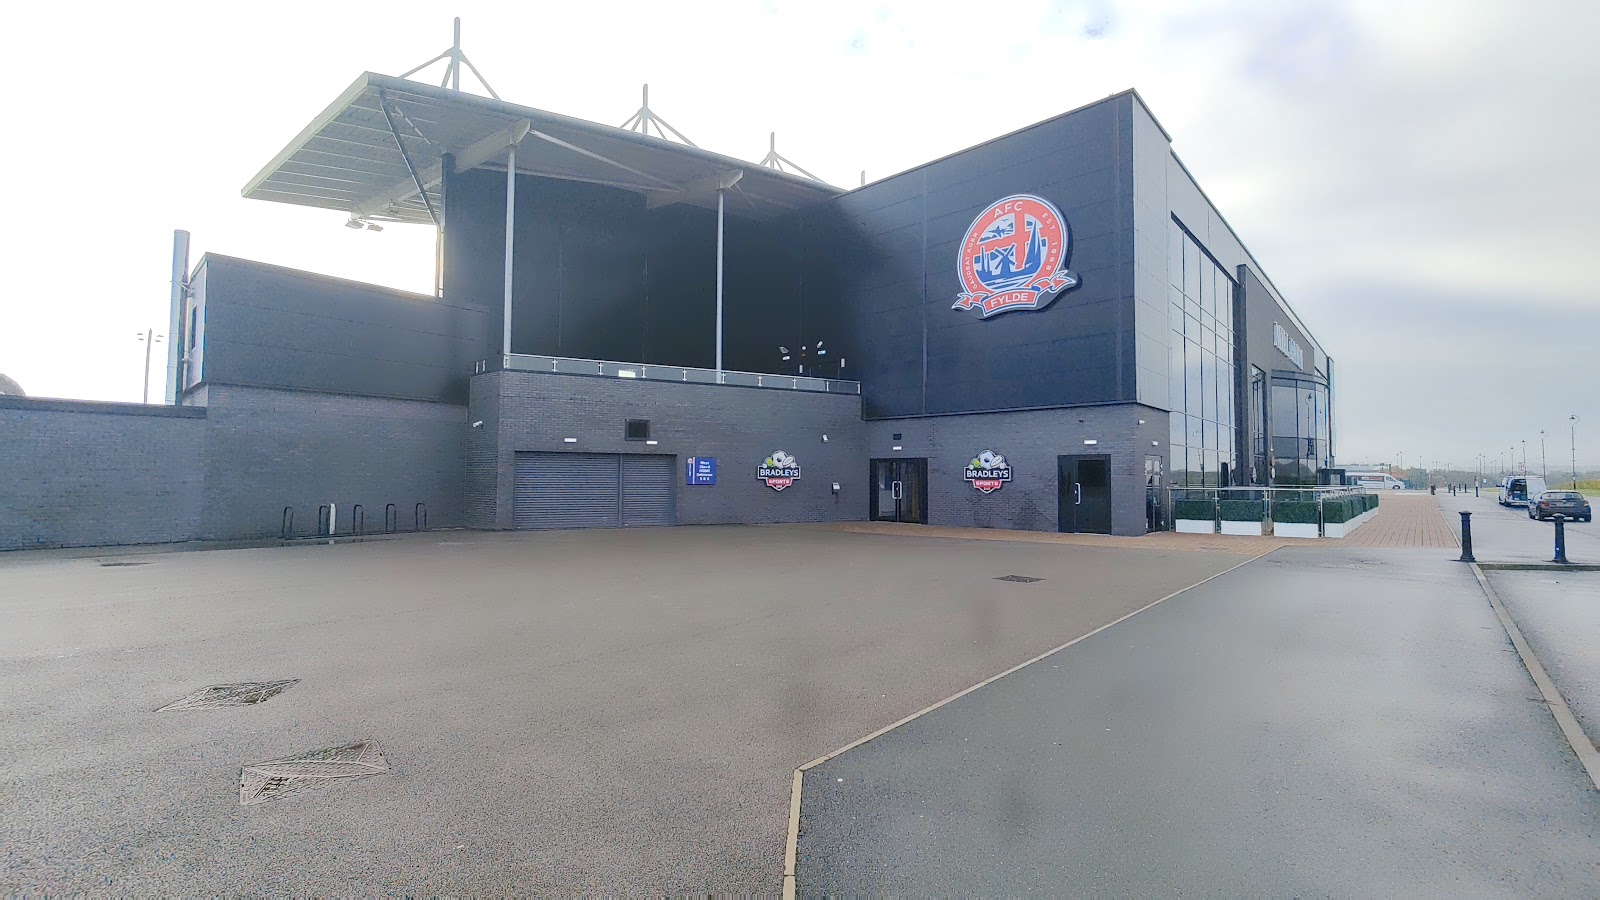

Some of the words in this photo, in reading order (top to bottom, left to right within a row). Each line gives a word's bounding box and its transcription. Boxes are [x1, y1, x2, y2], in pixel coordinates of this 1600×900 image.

[993, 201, 1024, 218] AFC
[990, 292, 1029, 308] FYLDE
[760, 468, 799, 476] BRADLEYS
[966, 470, 1009, 478] BRADLEYS
